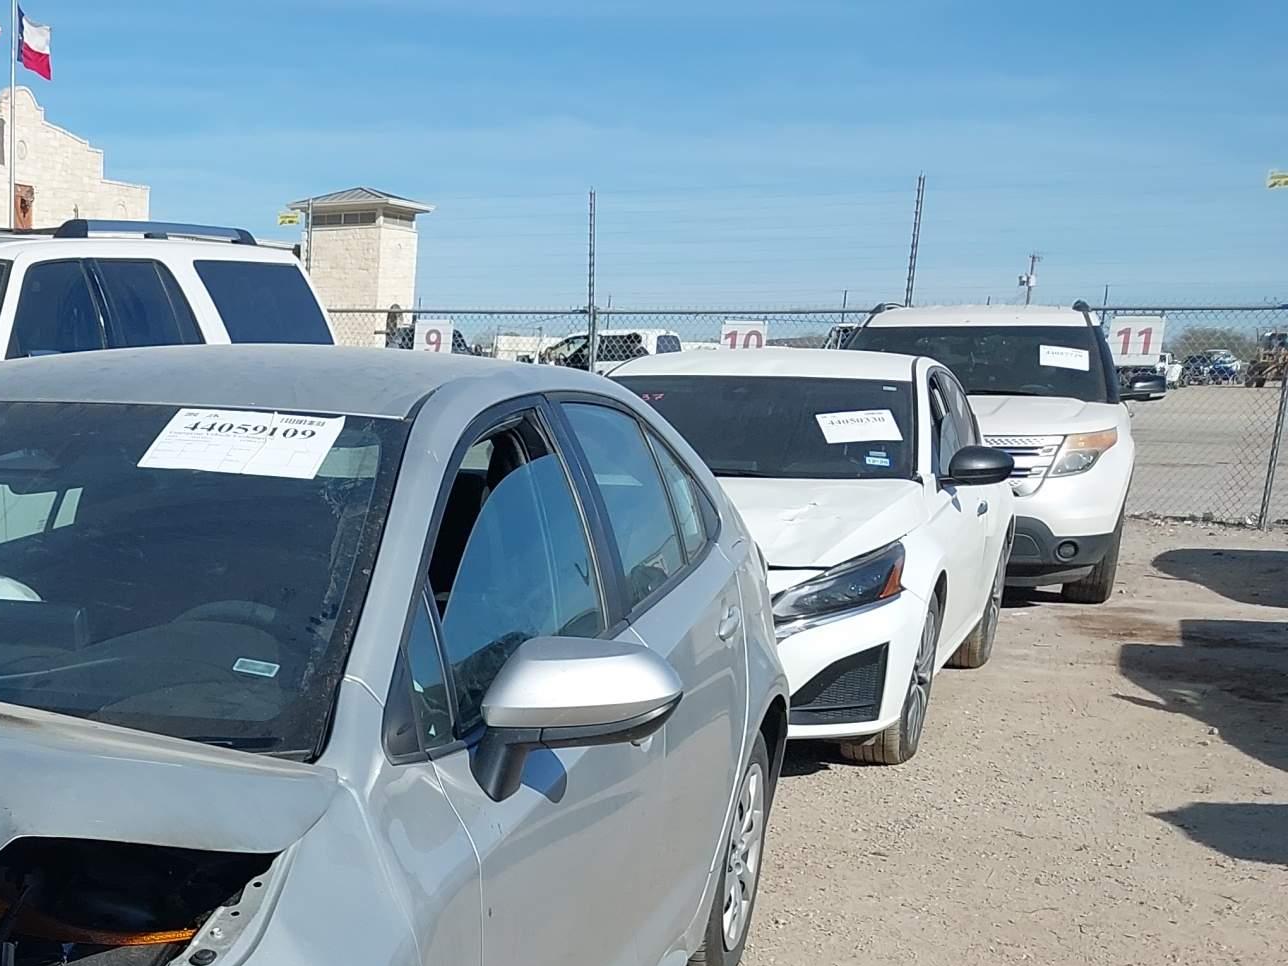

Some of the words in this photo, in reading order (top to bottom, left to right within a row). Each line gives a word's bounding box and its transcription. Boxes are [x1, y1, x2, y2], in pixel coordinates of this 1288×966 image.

[425, 328, 442, 353] 9
[724, 329, 763, 350] 10
[1116, 326, 1153, 355] 11
[183, 420, 317, 440] 44059109
